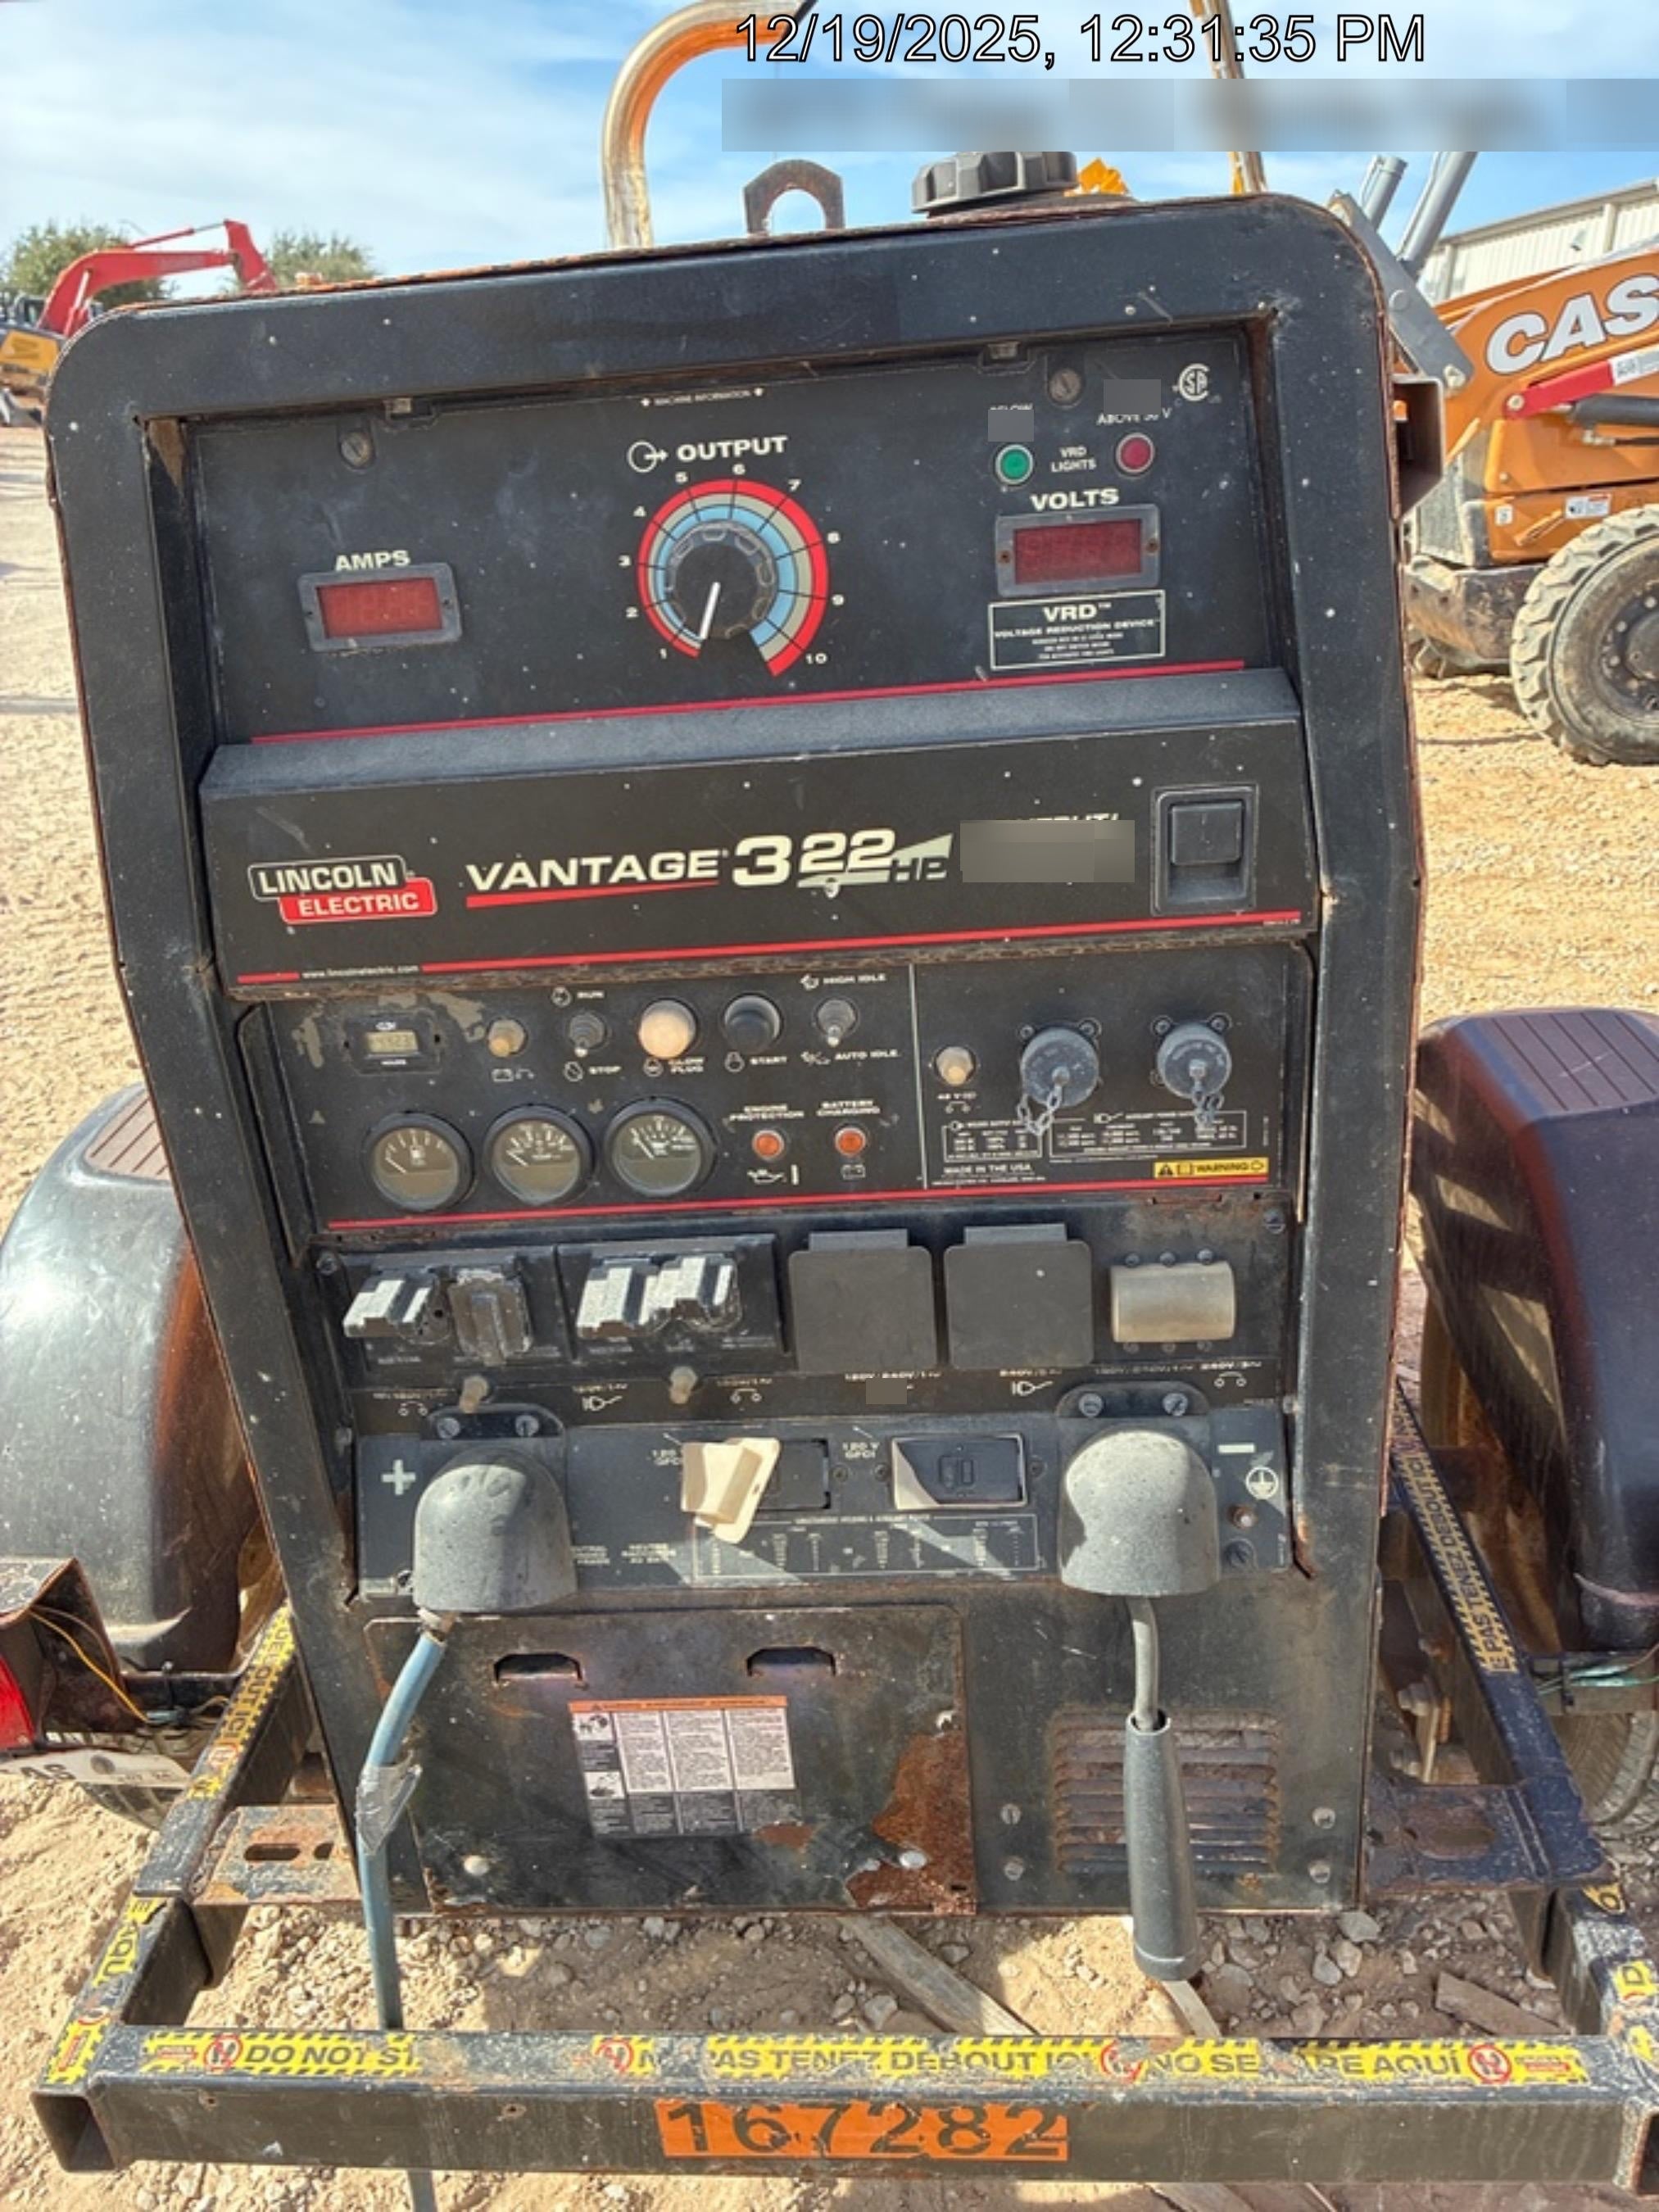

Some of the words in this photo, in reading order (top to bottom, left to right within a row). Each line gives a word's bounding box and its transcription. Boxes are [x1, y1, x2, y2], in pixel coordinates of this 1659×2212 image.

[677, 435, 789, 462] OUTPUT
[1059, 446, 1087, 458] VRD
[732, 464, 746, 476] 6
[1050, 458, 1097, 473] LIGHTS
[675, 472, 688, 483] 5
[787, 478, 802, 492] 7
[1031, 488, 1119, 511] VOLTS
[633, 505, 646, 518] 4
[334, 549, 410, 572] AMPS
[619, 555, 632, 567] 3
[831, 594, 845, 606] 9
[625, 608, 639, 619] 2
[660, 647, 669, 659] 1
[805, 652, 827, 664] 10
[732, 827, 896, 887] 322
[257, 862, 398, 895] LINCOLN
[297, 893, 420, 917] ELECTRIC
[835, 1051, 868, 1060] AUTO
[869, 1049, 900, 1058] IDLE
[588, 1065, 622, 1075] STOP
[975, 1165, 986, 1173] IN
[988, 1163, 1008, 1172] THE
[1009, 1163, 1032, 1172] USA
[1195, 1161, 1249, 1173] WARNING
[654, 1457, 683, 1466] GFC
[244, 2045, 295, 2065] DO
[1210, 2053, 1259, 2073] SE
[667, 2101, 1060, 2155] 167282
